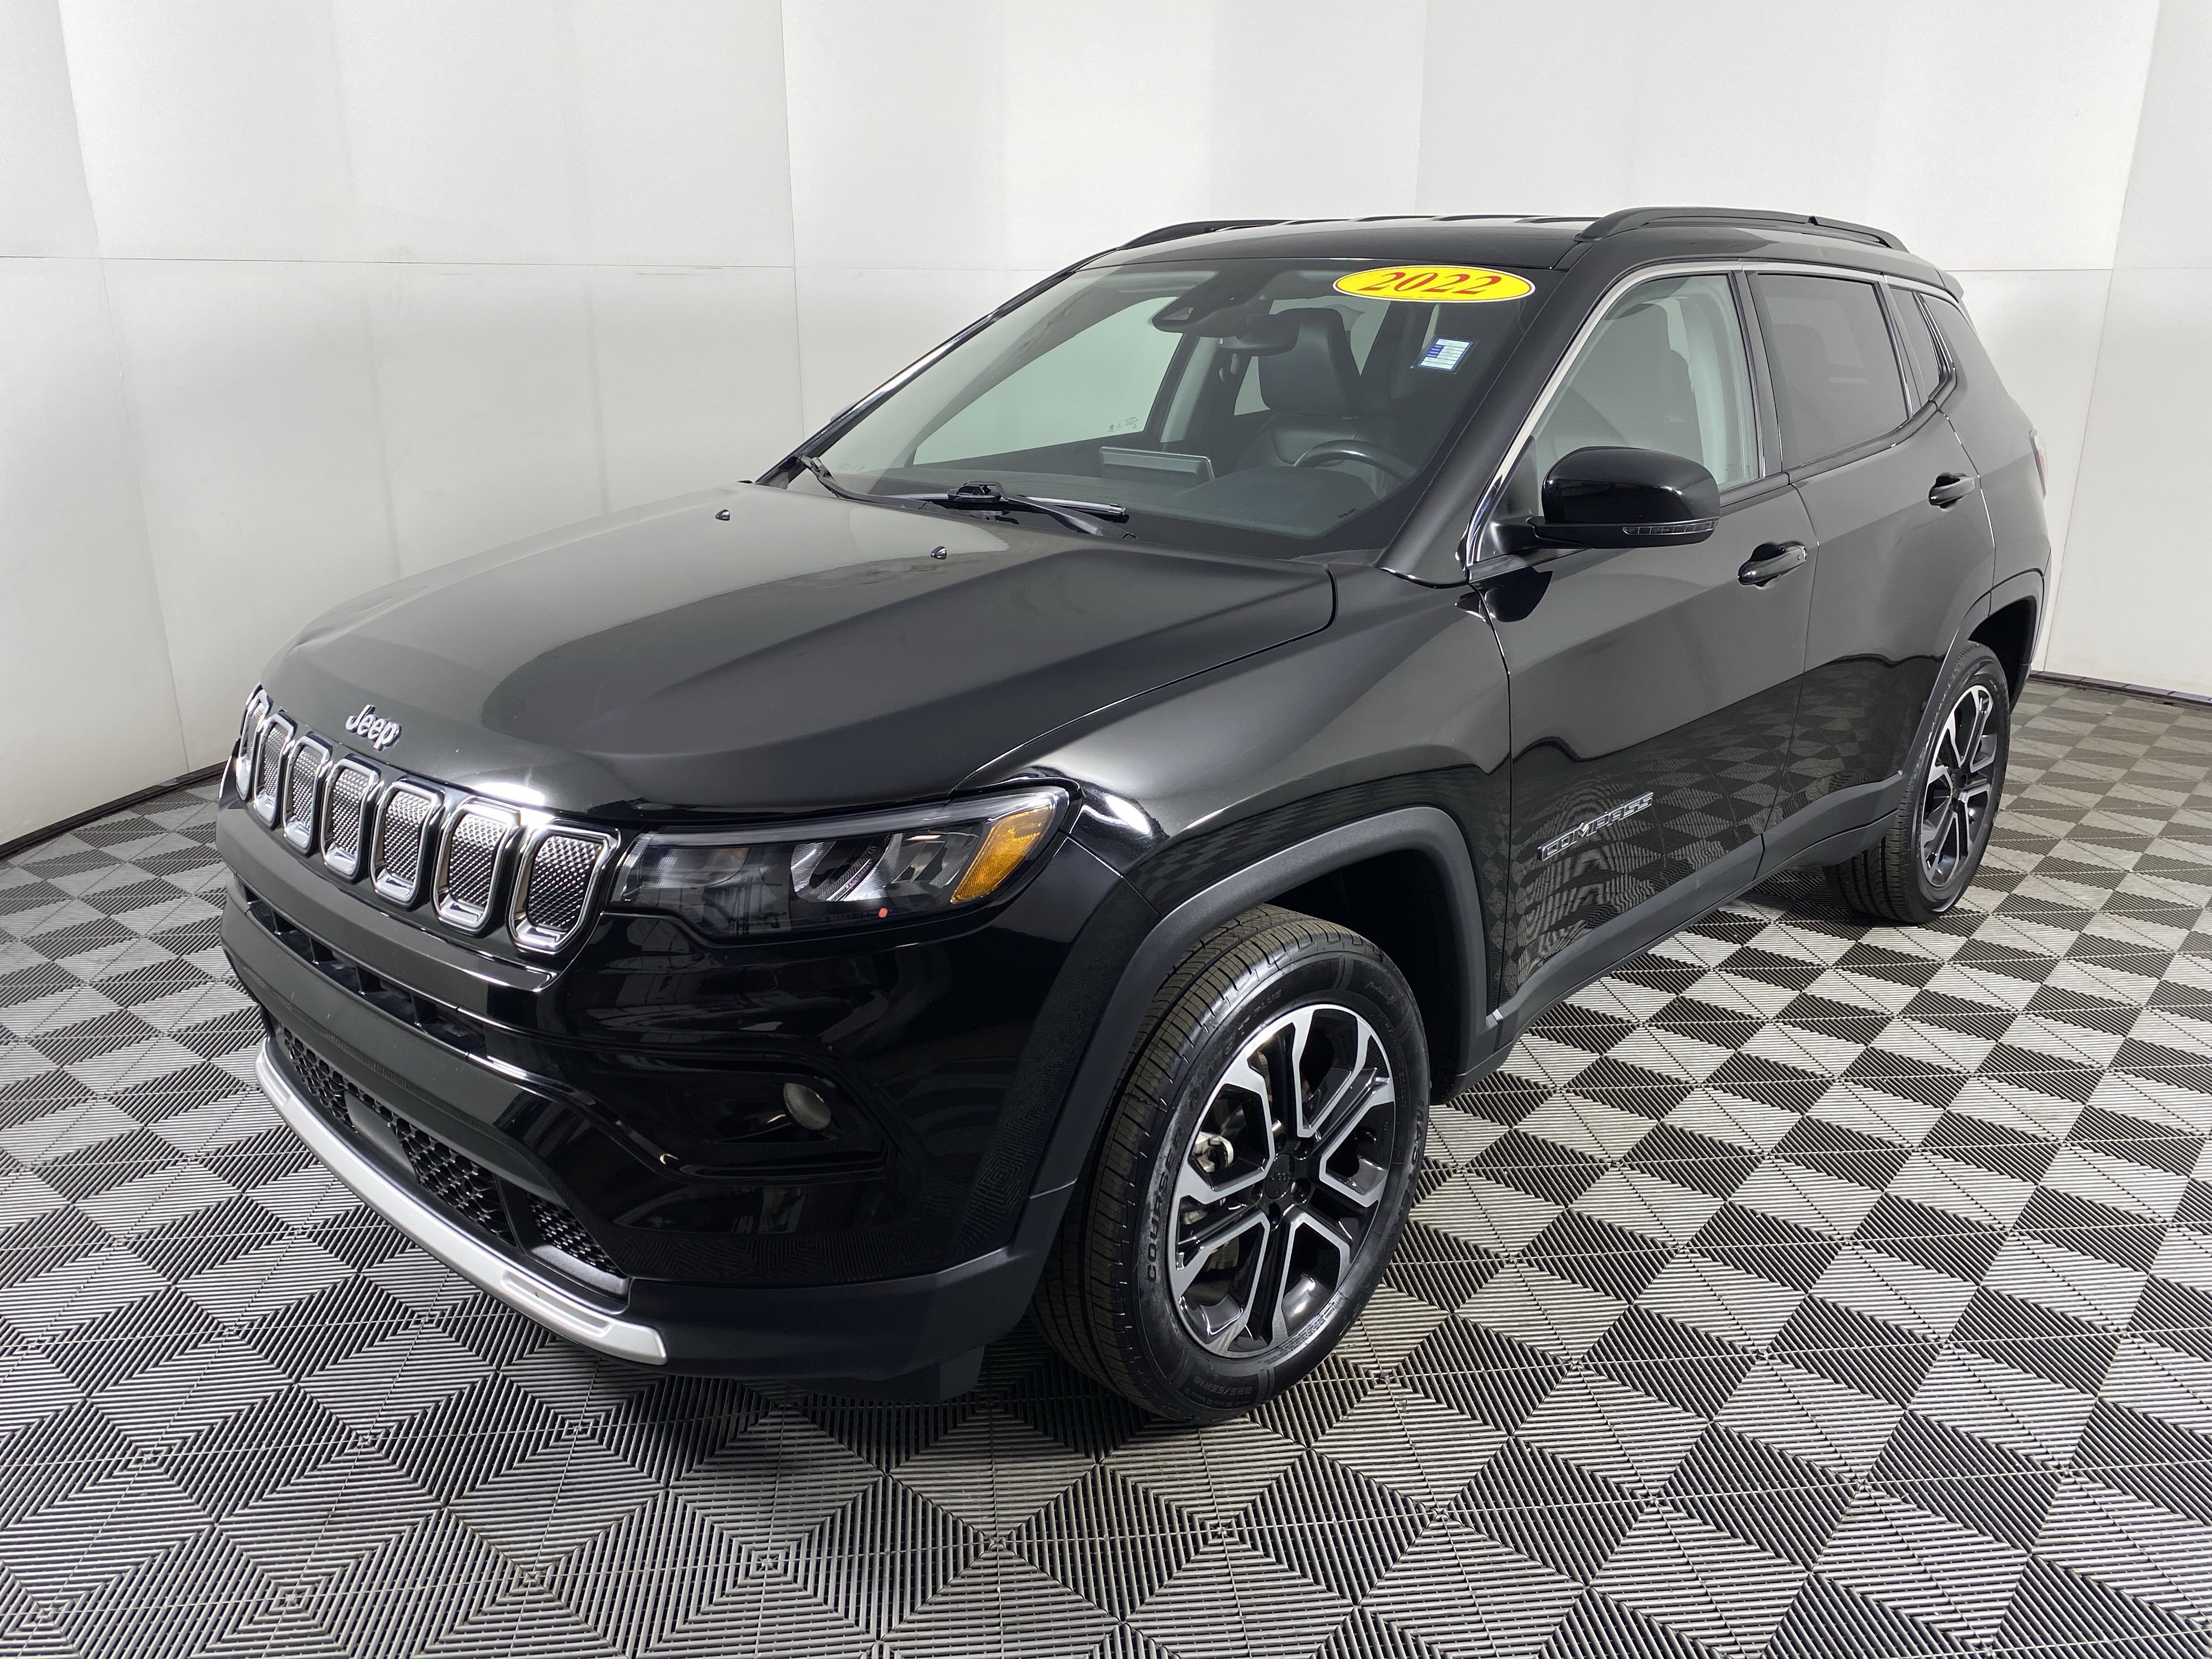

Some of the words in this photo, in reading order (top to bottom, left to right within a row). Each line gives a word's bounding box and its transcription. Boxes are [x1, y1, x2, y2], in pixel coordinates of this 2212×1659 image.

[1357, 272, 1502, 294] 2022
[345, 704, 402, 751] Jeep
[1538, 792, 1654, 861] COMPASS
[1147, 1126, 1183, 1283] COURSER
